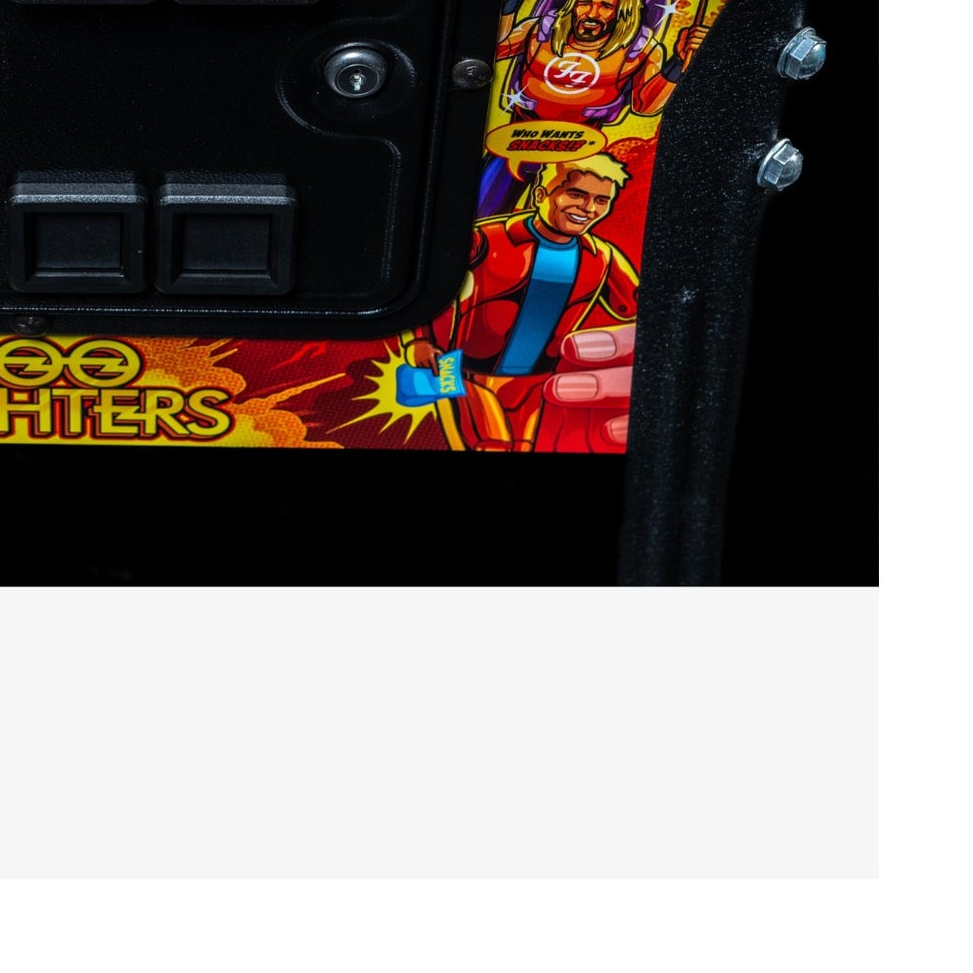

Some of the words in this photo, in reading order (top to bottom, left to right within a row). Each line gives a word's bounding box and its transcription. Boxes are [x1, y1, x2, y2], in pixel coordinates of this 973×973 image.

[511, 129, 539, 138] WHO
[540, 130, 584, 138] WANTS
[438, 358, 456, 394] SNACKS
